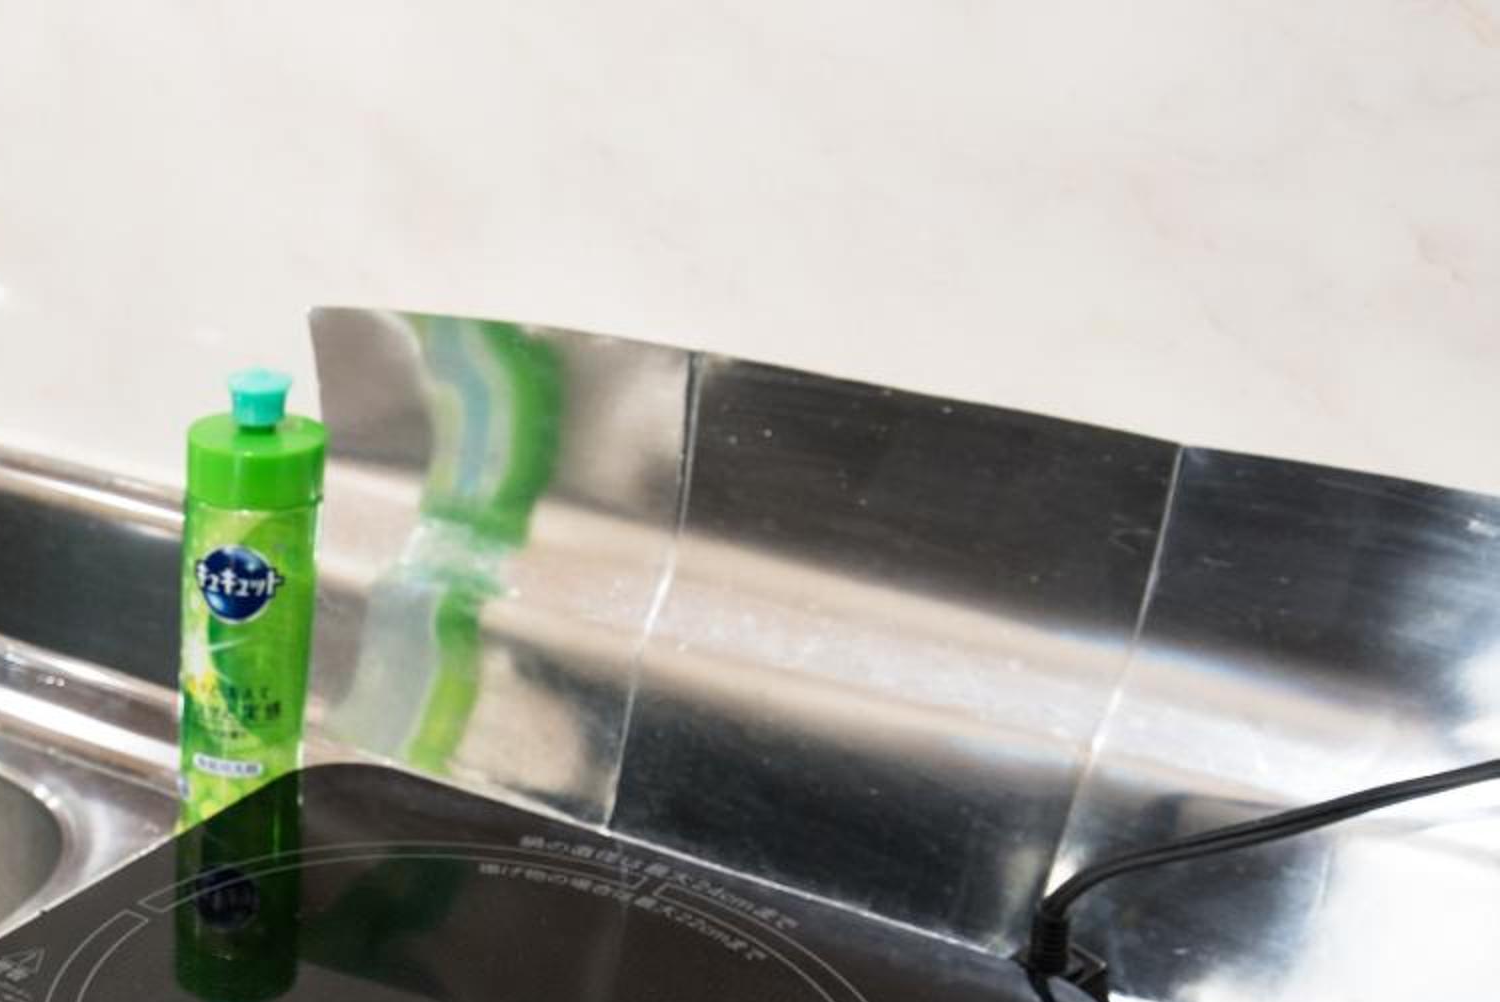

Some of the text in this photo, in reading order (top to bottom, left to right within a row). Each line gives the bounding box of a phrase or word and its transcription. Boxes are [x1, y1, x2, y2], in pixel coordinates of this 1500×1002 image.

[197, 561, 283, 596] キュキュット
